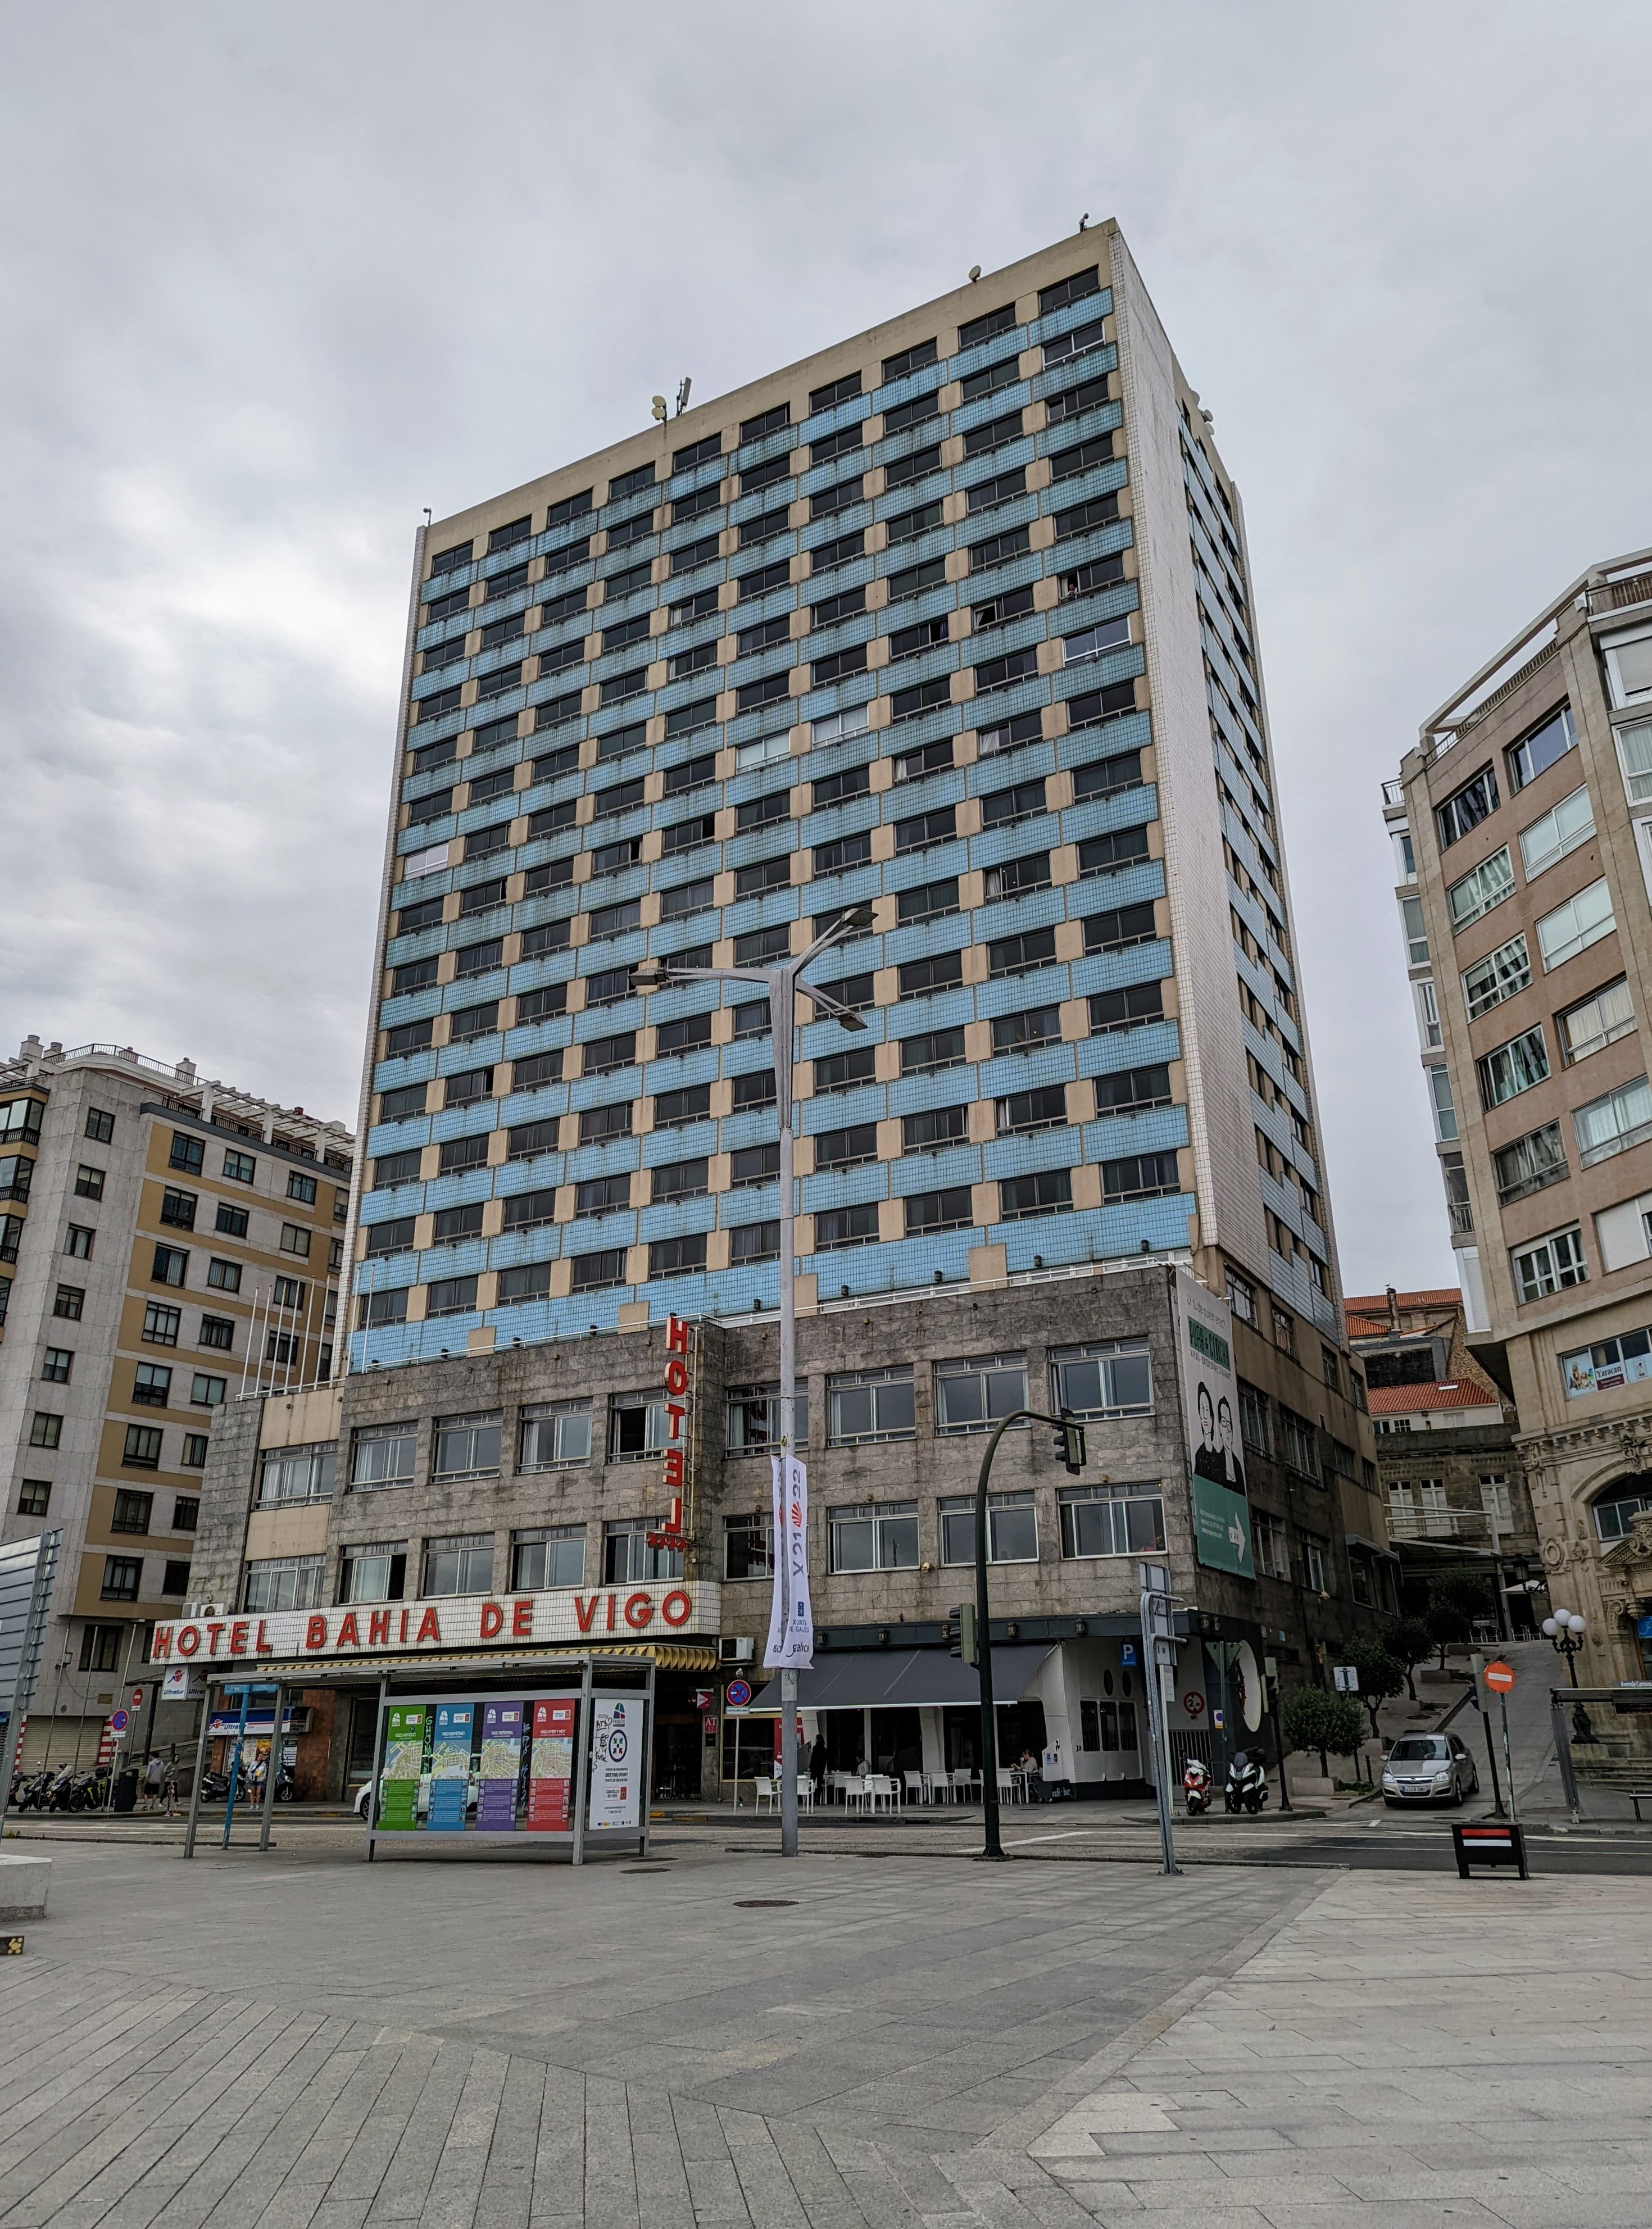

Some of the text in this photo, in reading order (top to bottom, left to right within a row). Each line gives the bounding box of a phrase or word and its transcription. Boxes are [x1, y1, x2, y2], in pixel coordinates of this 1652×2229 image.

[1596, 1366, 1622, 1378] Yaracan
[153, 1590, 692, 1659] HOTEL BAHIA DE VIGO
[1123, 1644, 1134, 1660] P
[1187, 1699, 1195, 1708] 2
[705, 1717, 717, 1726] AT
